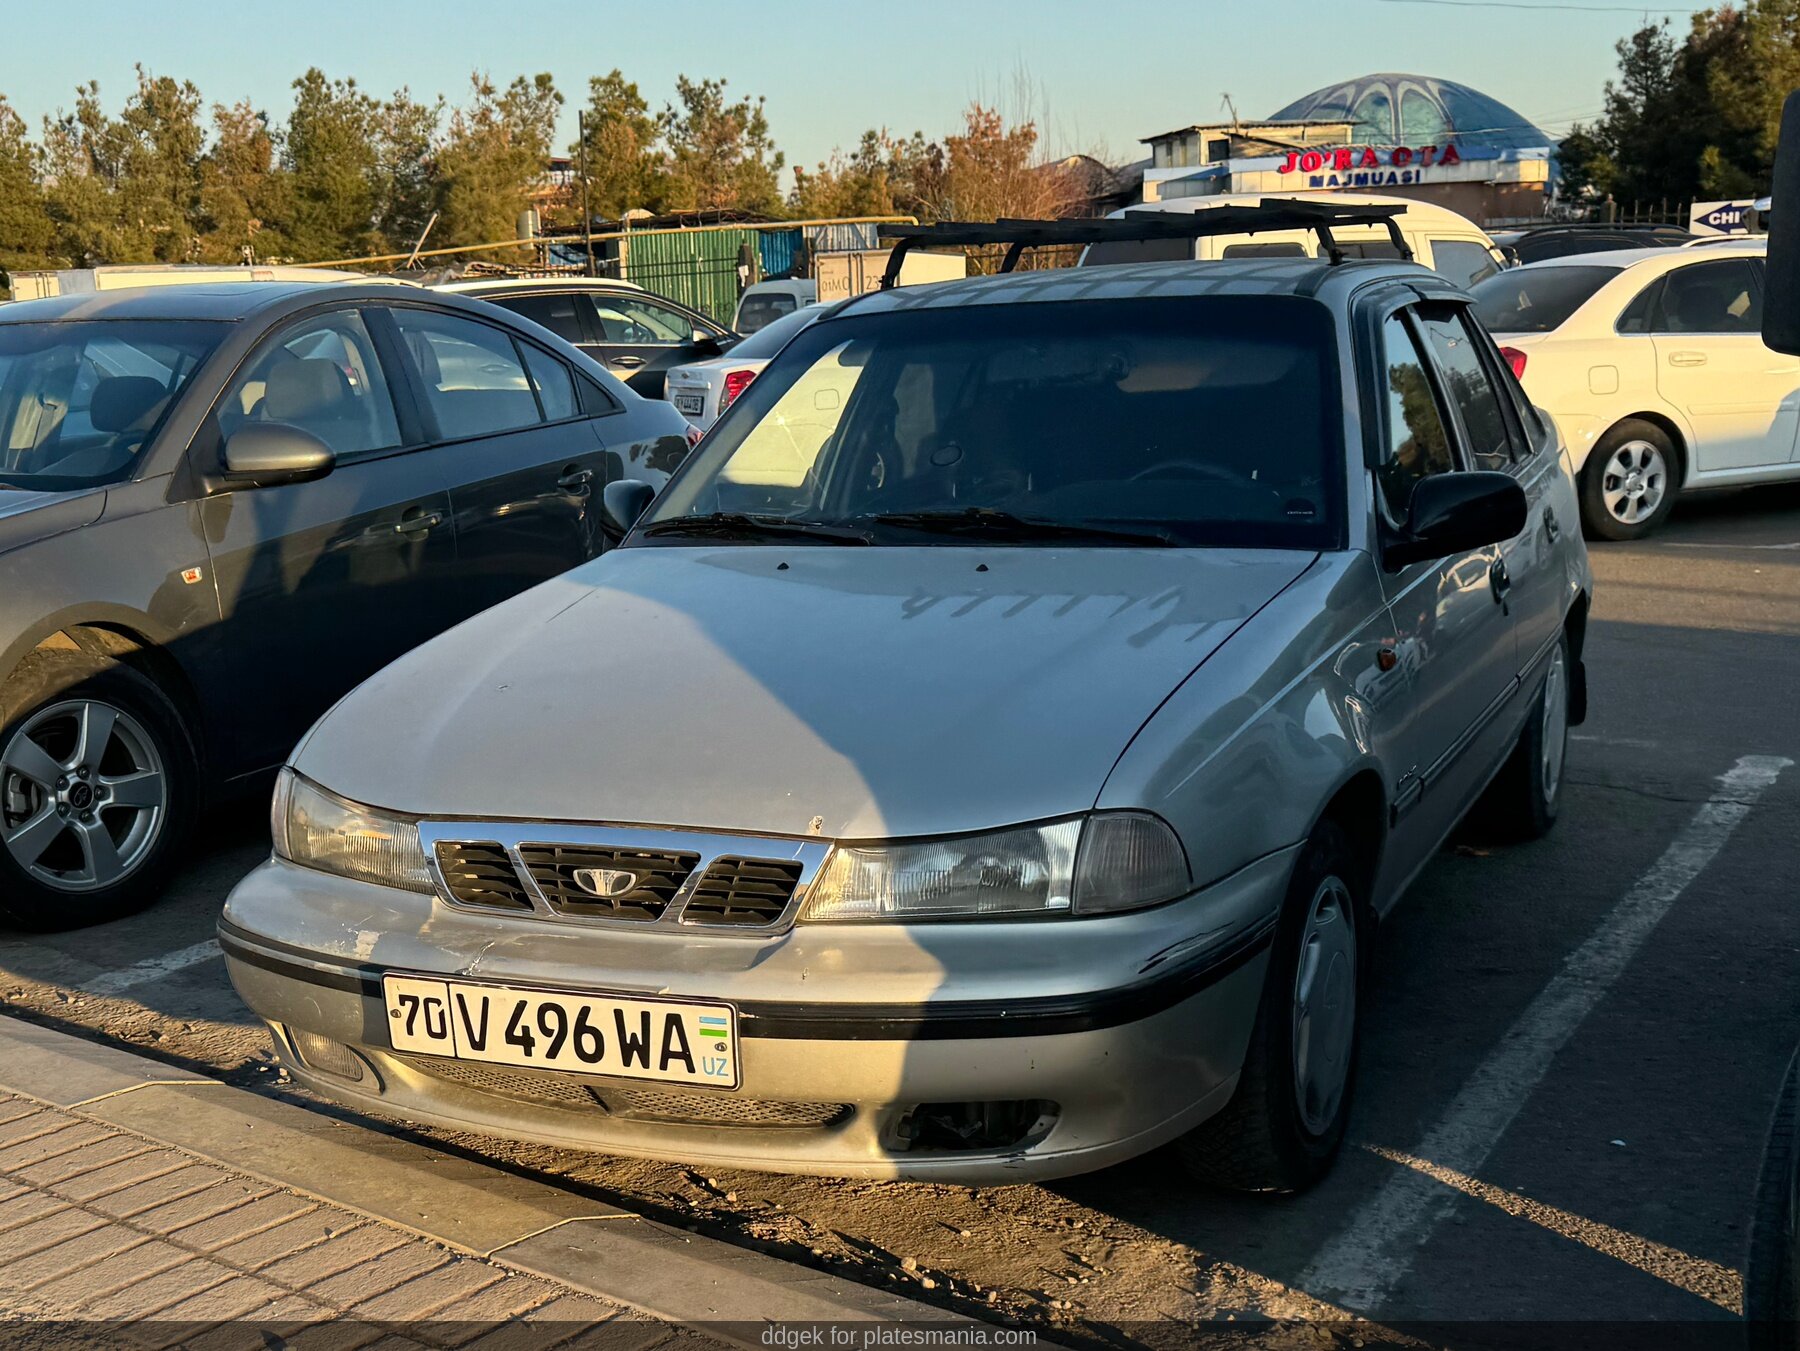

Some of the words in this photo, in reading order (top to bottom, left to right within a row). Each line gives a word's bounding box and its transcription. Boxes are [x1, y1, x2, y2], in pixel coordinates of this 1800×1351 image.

[1309, 169, 1421, 188] MAJMUASI
[398, 994, 448, 1040] 70
[455, 993, 490, 1052] V
[504, 999, 605, 1064] 496
[613, 1008, 696, 1074] WA
[702, 1056, 729, 1077] UZ
